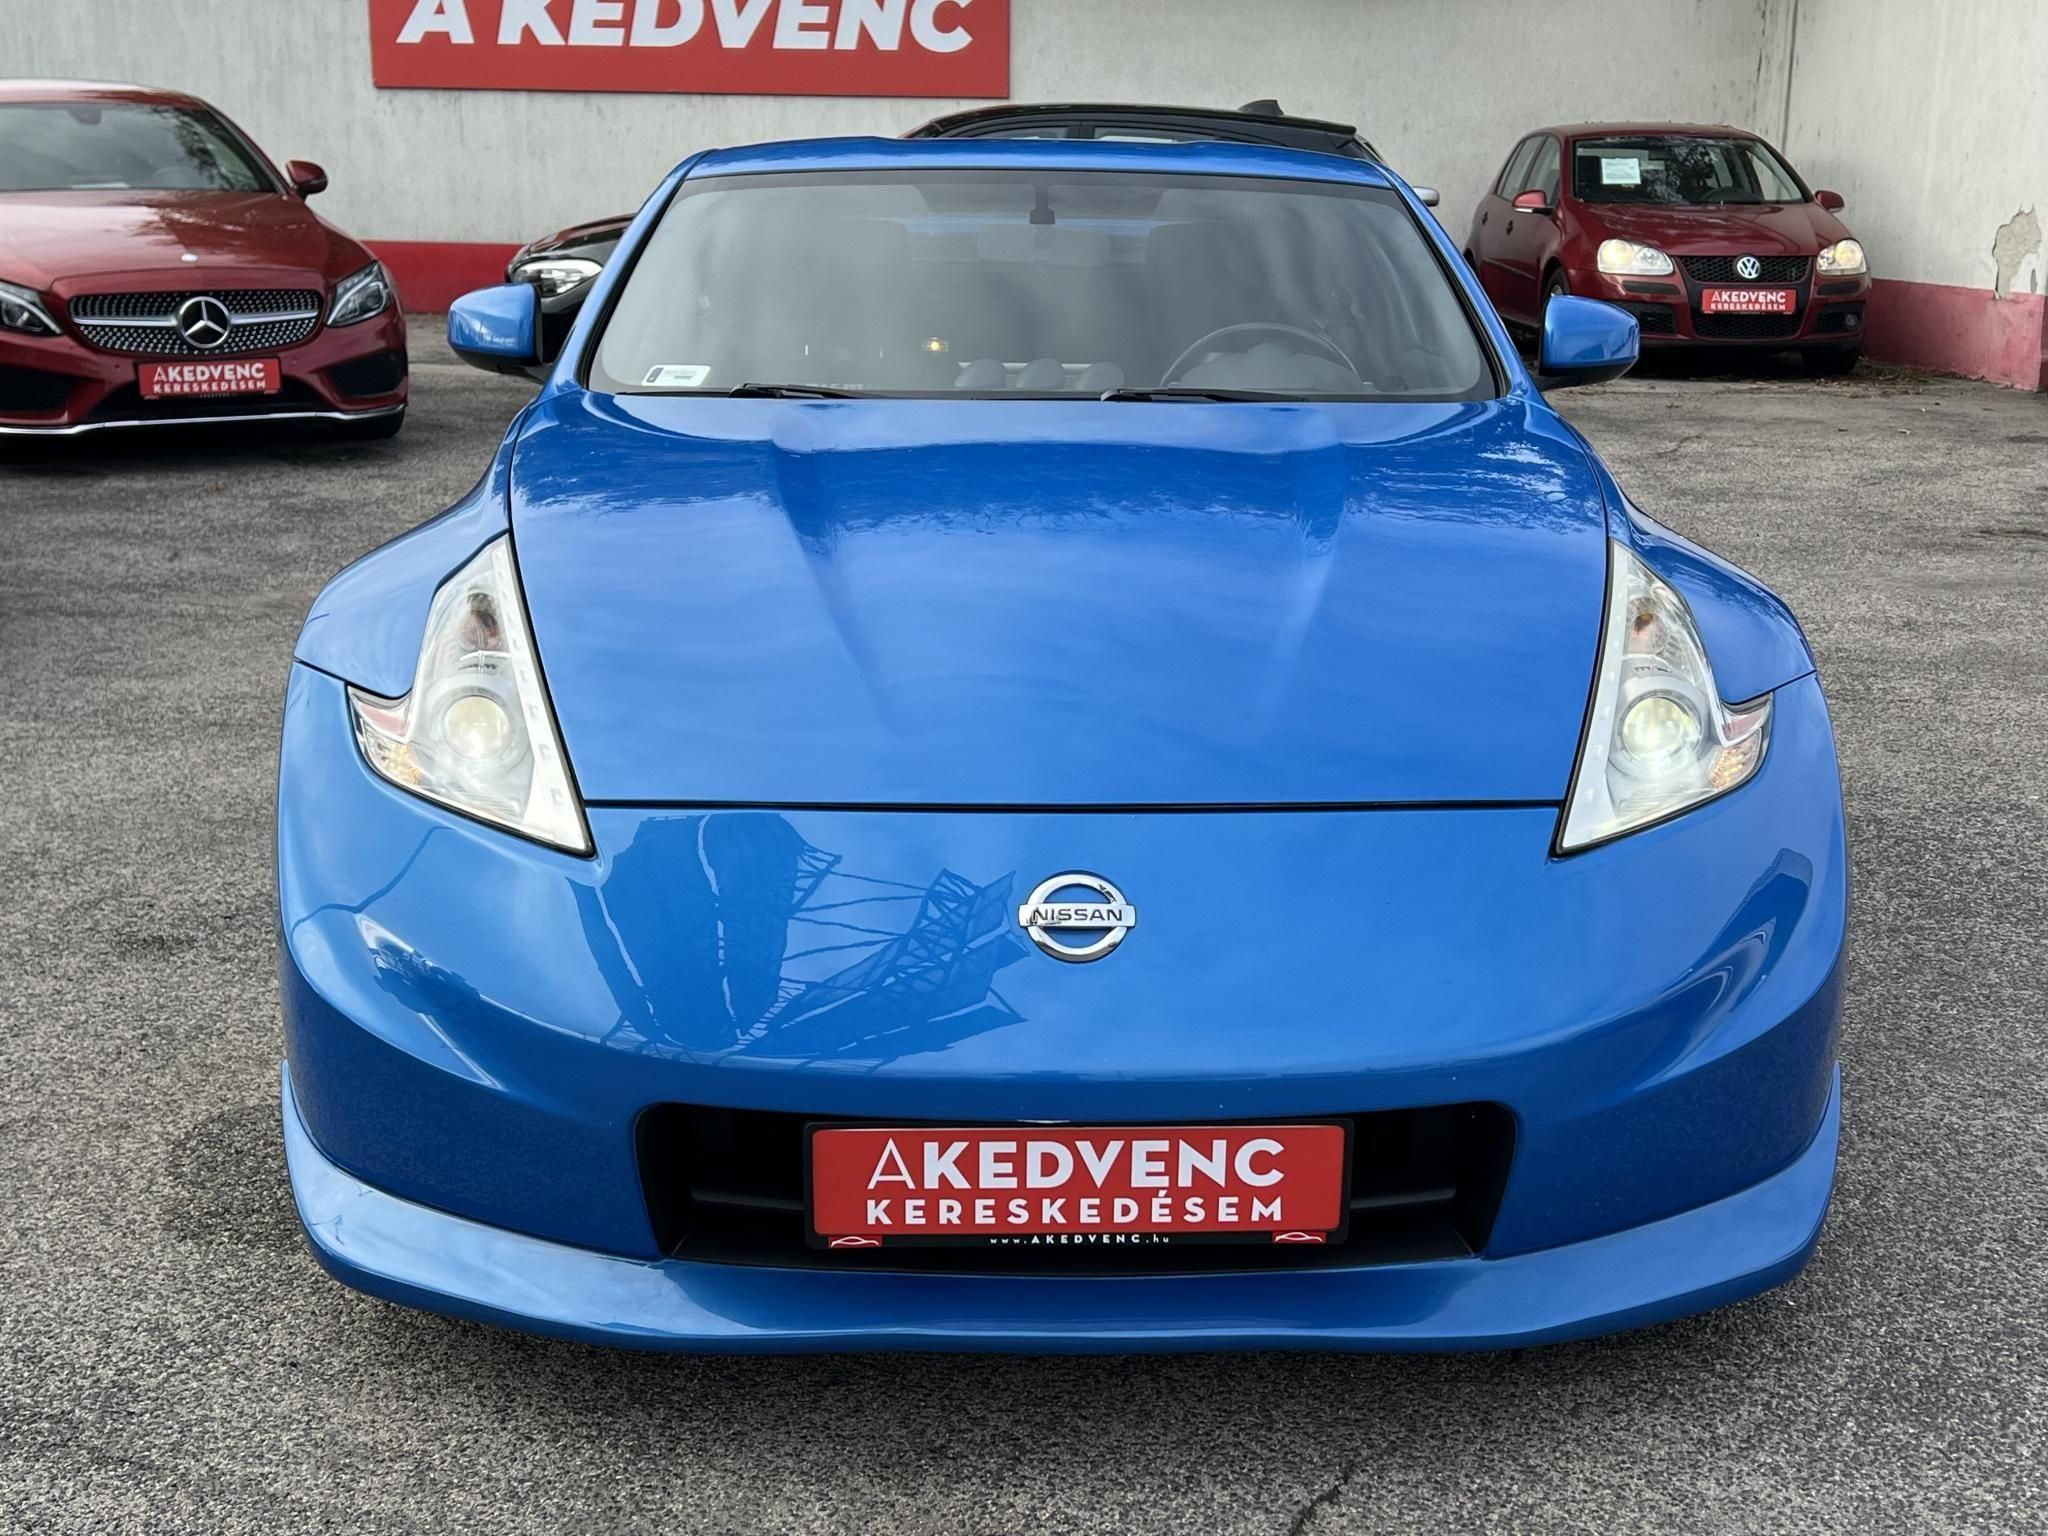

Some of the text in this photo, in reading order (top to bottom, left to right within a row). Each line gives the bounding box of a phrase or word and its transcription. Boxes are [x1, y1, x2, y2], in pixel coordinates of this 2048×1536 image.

[396, 0, 973, 53] A KEDVENC
[1032, 908, 1122, 921] NISSAN
[867, 1189, 1282, 1225] KERESKEDÉSEM
[989, 1234, 1170, 1245] www.AKEDVENC.hu
